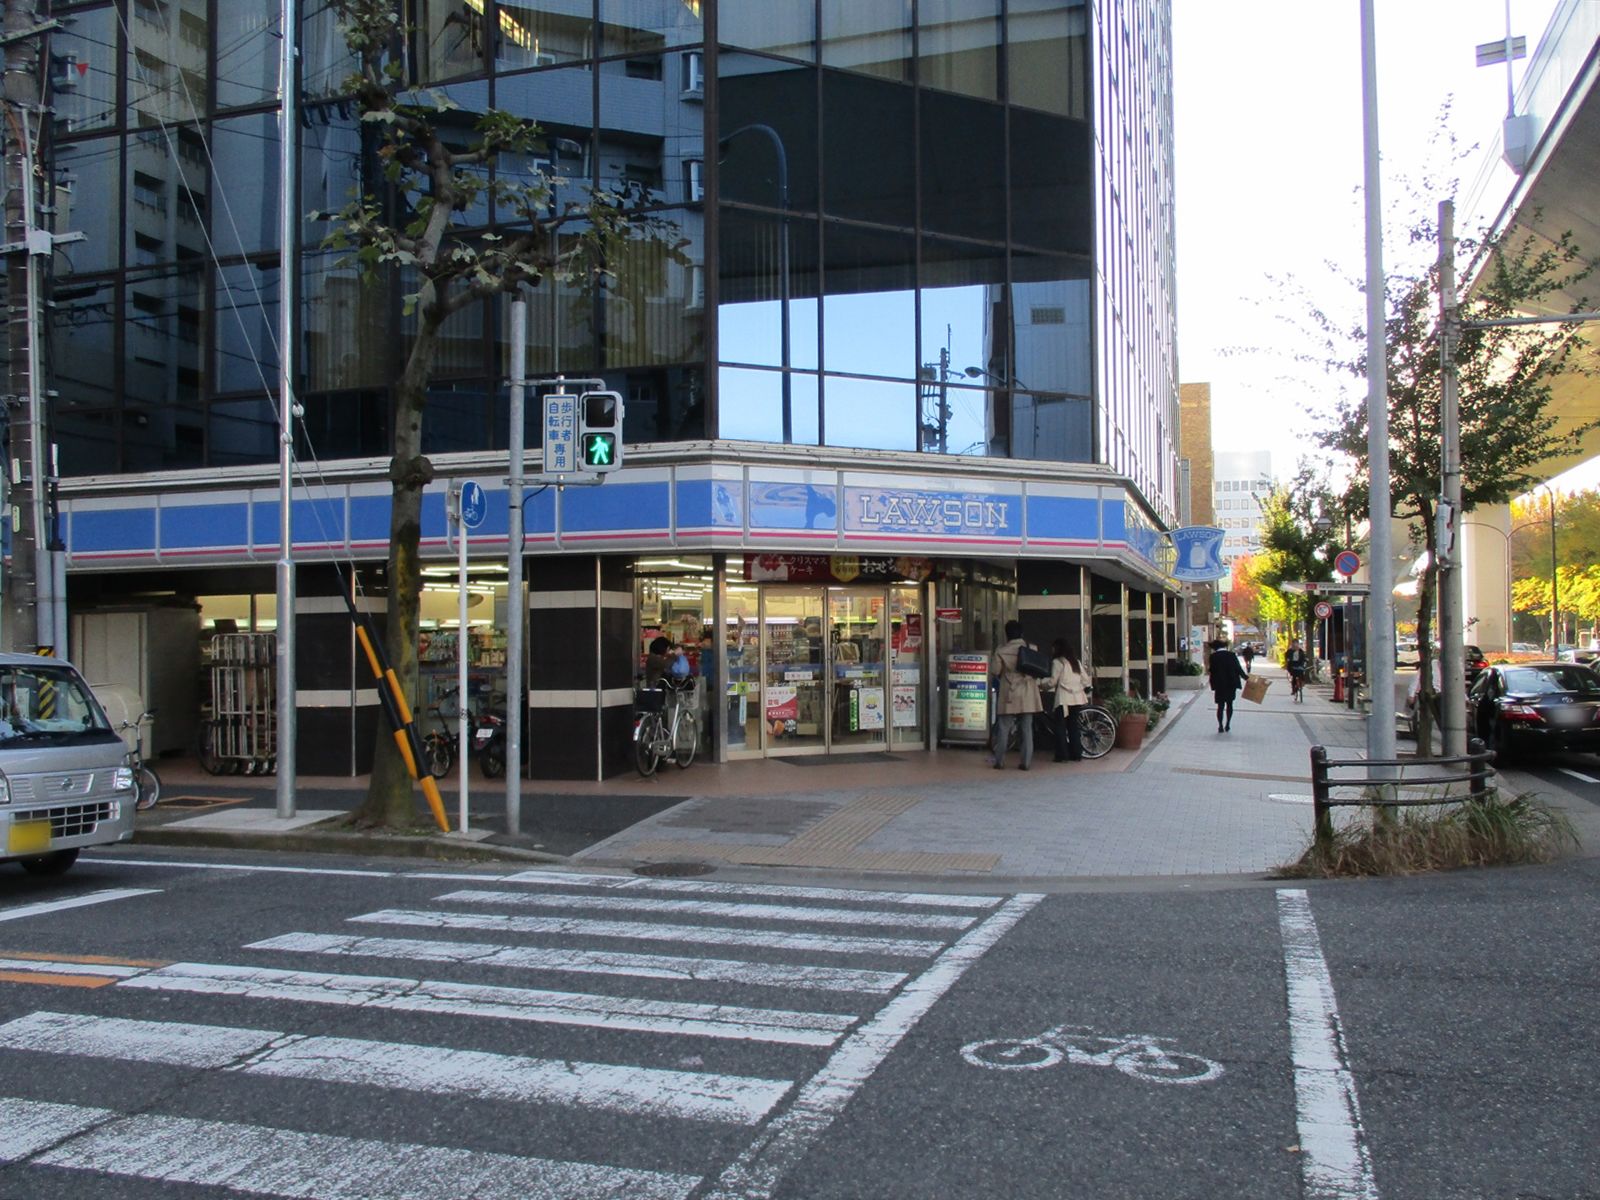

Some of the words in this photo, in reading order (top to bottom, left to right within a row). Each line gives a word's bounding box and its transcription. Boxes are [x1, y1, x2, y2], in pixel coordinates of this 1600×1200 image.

[548, 402, 560, 441] 自転車
[561, 401, 573, 441] 歩行者
[554, 443, 567, 468] 専用
[860, 495, 1008, 528] LAWSON
[791, 556, 828, 566] クリスマス
[791, 566, 815, 575] ケーキ
